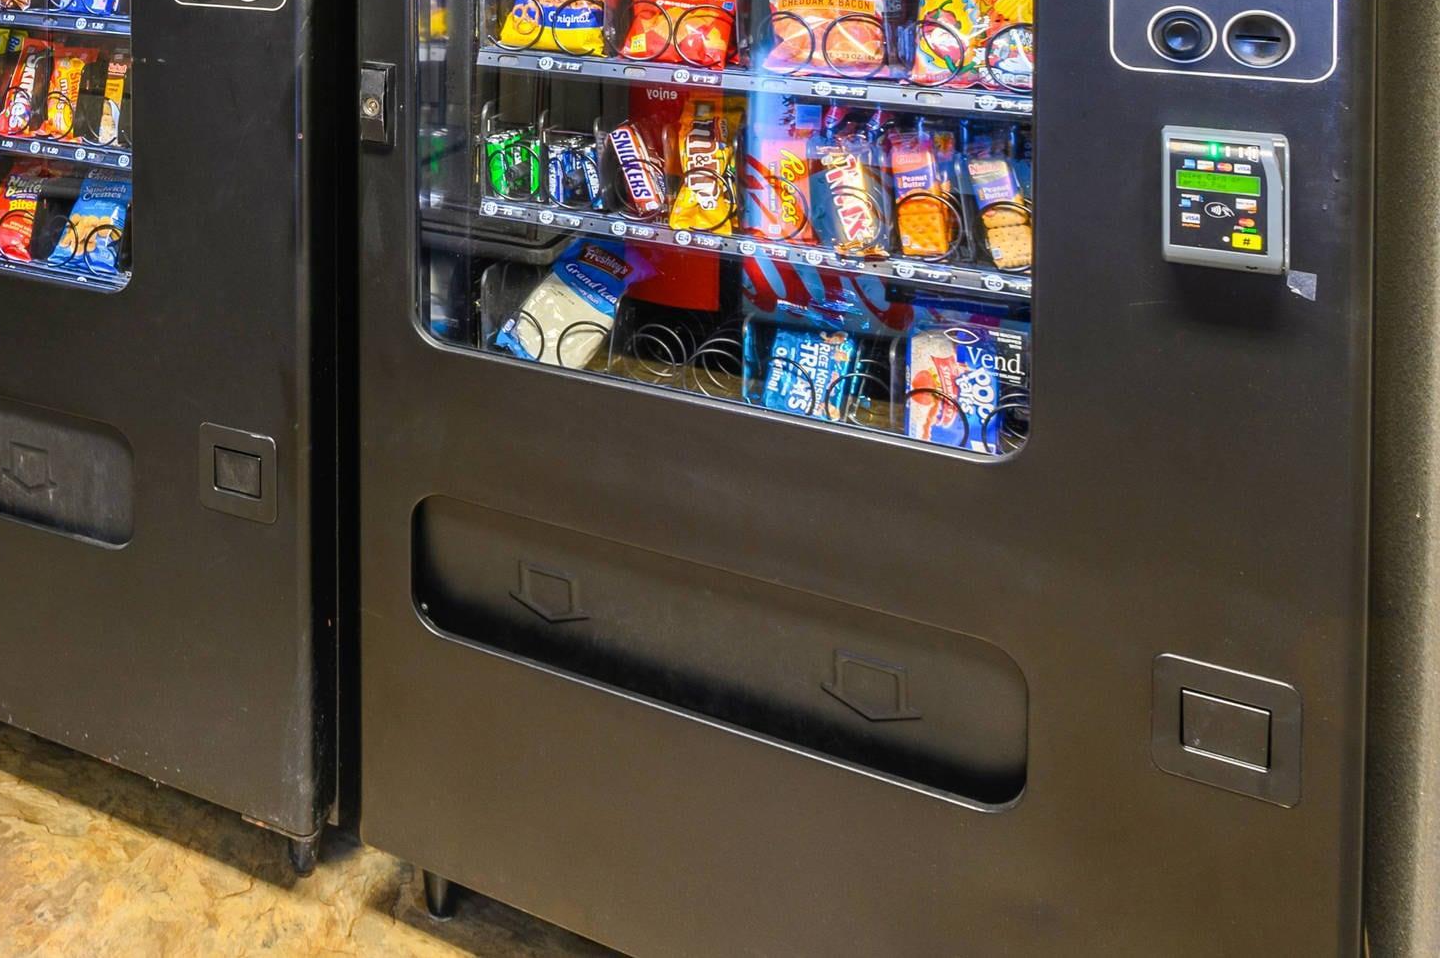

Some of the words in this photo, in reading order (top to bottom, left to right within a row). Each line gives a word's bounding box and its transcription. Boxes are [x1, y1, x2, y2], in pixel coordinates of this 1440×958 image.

[837, 0, 871, 10] BACON
[612, 129, 652, 199] SNICKERS
[780, 149, 806, 226] Reese's
[901, 175, 928, 183] Peanut
[983, 185, 1010, 194] Peanut
[565, 263, 601, 290] Grand
[818, 342, 831, 361] RICE
